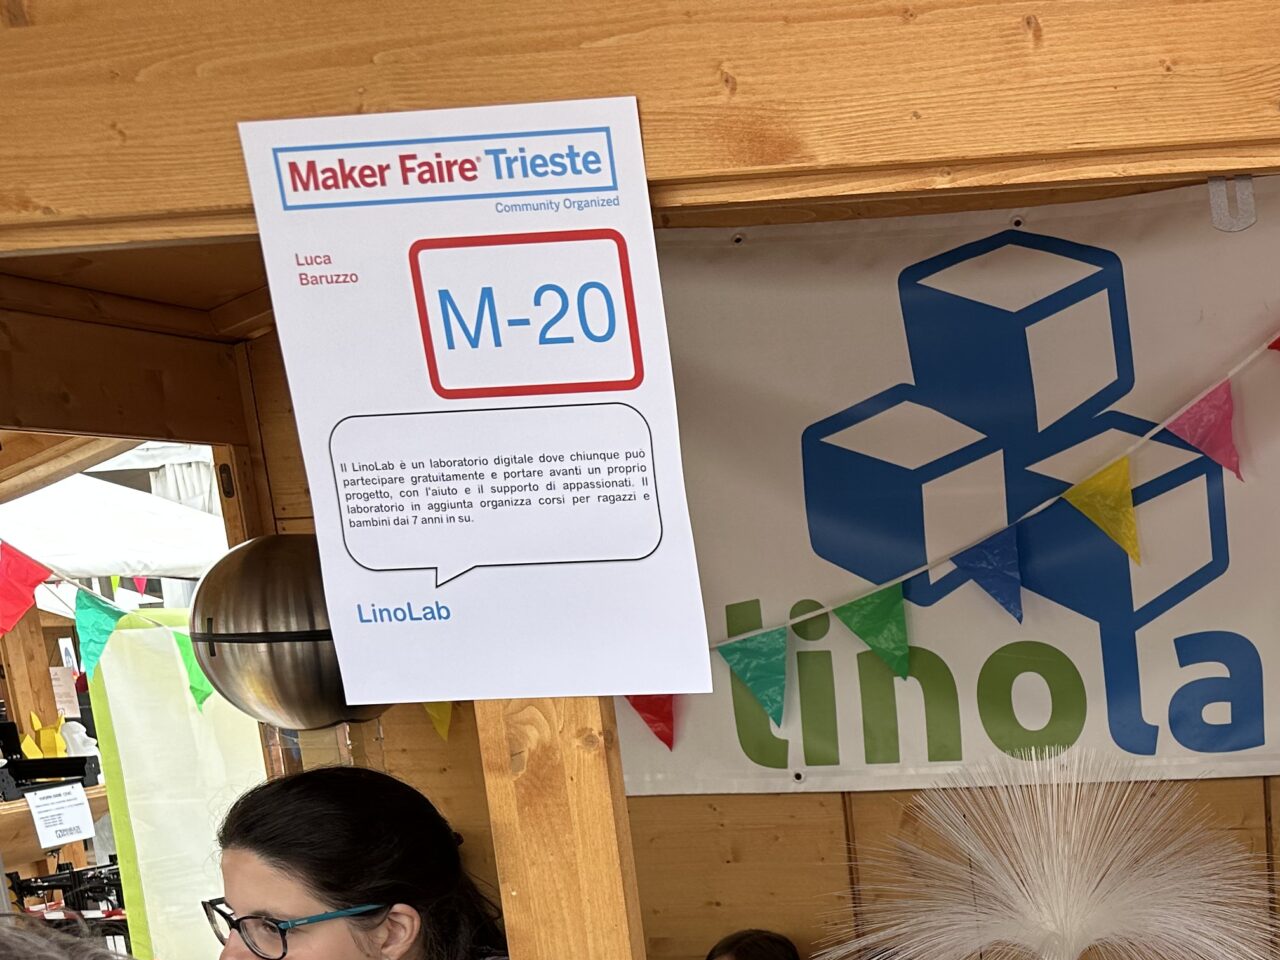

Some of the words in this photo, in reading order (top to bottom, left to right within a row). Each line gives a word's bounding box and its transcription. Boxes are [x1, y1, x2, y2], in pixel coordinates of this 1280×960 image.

[288, 158, 391, 192] Maker
[399, 152, 479, 186] Faire
[485, 143, 602, 180] Trieste
[494, 198, 560, 214] Community
[563, 195, 620, 211] Organized
[295, 252, 332, 267] Luca
[298, 270, 358, 287] Baruzzo
[437, 281, 618, 350] M-20
[340, 463, 347, 472] Il
[352, 461, 395, 472] LinoLab
[411, 460, 425, 469] un
[430, 456, 489, 468] laboratorio
[493, 454, 534, 467] digitale
[538, 452, 565, 463] dove
[569, 450, 620, 462] chiunque
[625, 449, 646, 461] può
[343, 475, 405, 488] partecipare
[410, 471, 485, 485] gratuitamente
[491, 471, 498, 480] e
[503, 468, 544, 481] portare
[549, 465, 582, 476] avanti
[587, 466, 601, 475] un
[607, 463, 647, 475] proprio
[345, 490, 393, 502] progetto,
[399, 489, 419, 498] con
[425, 486, 458, 496] l'aiuto
[478, 484, 484, 494] il
[490, 482, 539, 495] supporto
[545, 481, 556, 491] di
[562, 478, 634, 492] appassionati.
[641, 477, 648, 487] Il
[347, 502, 405, 514] laboratorio
[411, 502, 421, 511] in
[427, 499, 473, 513] aggiunta
[479, 496, 532, 510] organizza
[538, 494, 565, 505] corsi
[572, 495, 591, 506] per
[597, 492, 637, 504] ragazzi
[643, 492, 650, 501] e
[349, 517, 391, 528] bambini
[393, 516, 409, 526] dai
[411, 515, 418, 525] 7
[421, 514, 444, 525] anni
[446, 513, 456, 523] in
[458, 514, 474, 523] su.
[356, 600, 451, 624] LinoLab
